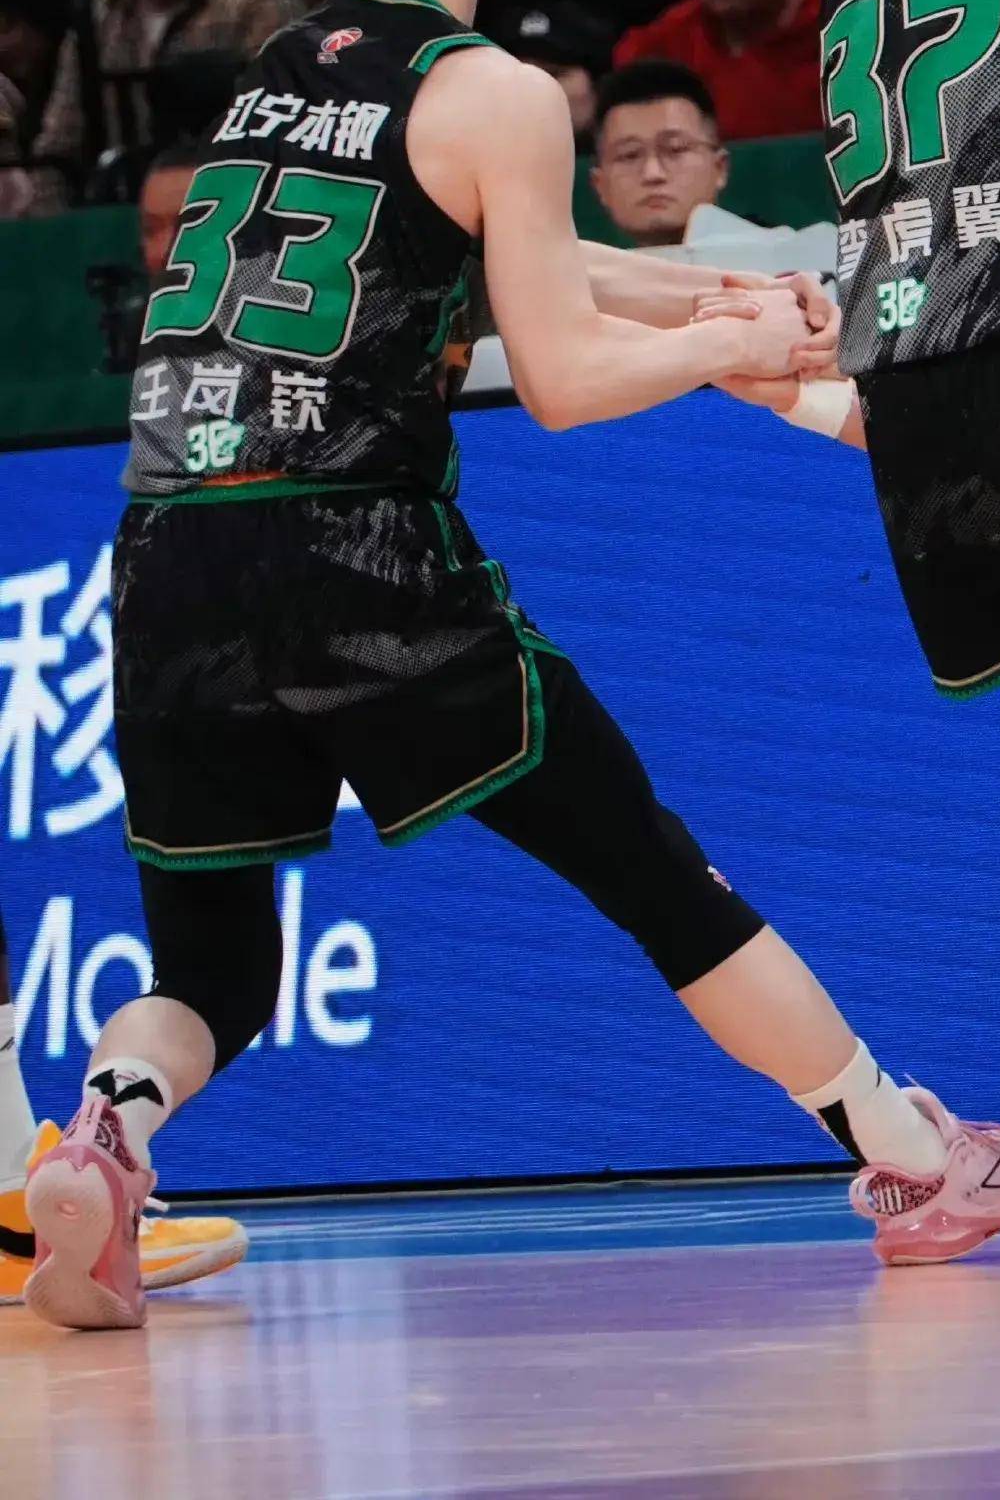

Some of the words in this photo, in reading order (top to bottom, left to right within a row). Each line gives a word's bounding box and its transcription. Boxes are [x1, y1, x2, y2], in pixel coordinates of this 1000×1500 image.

[212, 88, 391, 160] 辽宁本钢
[140, 159, 385, 362] 33
